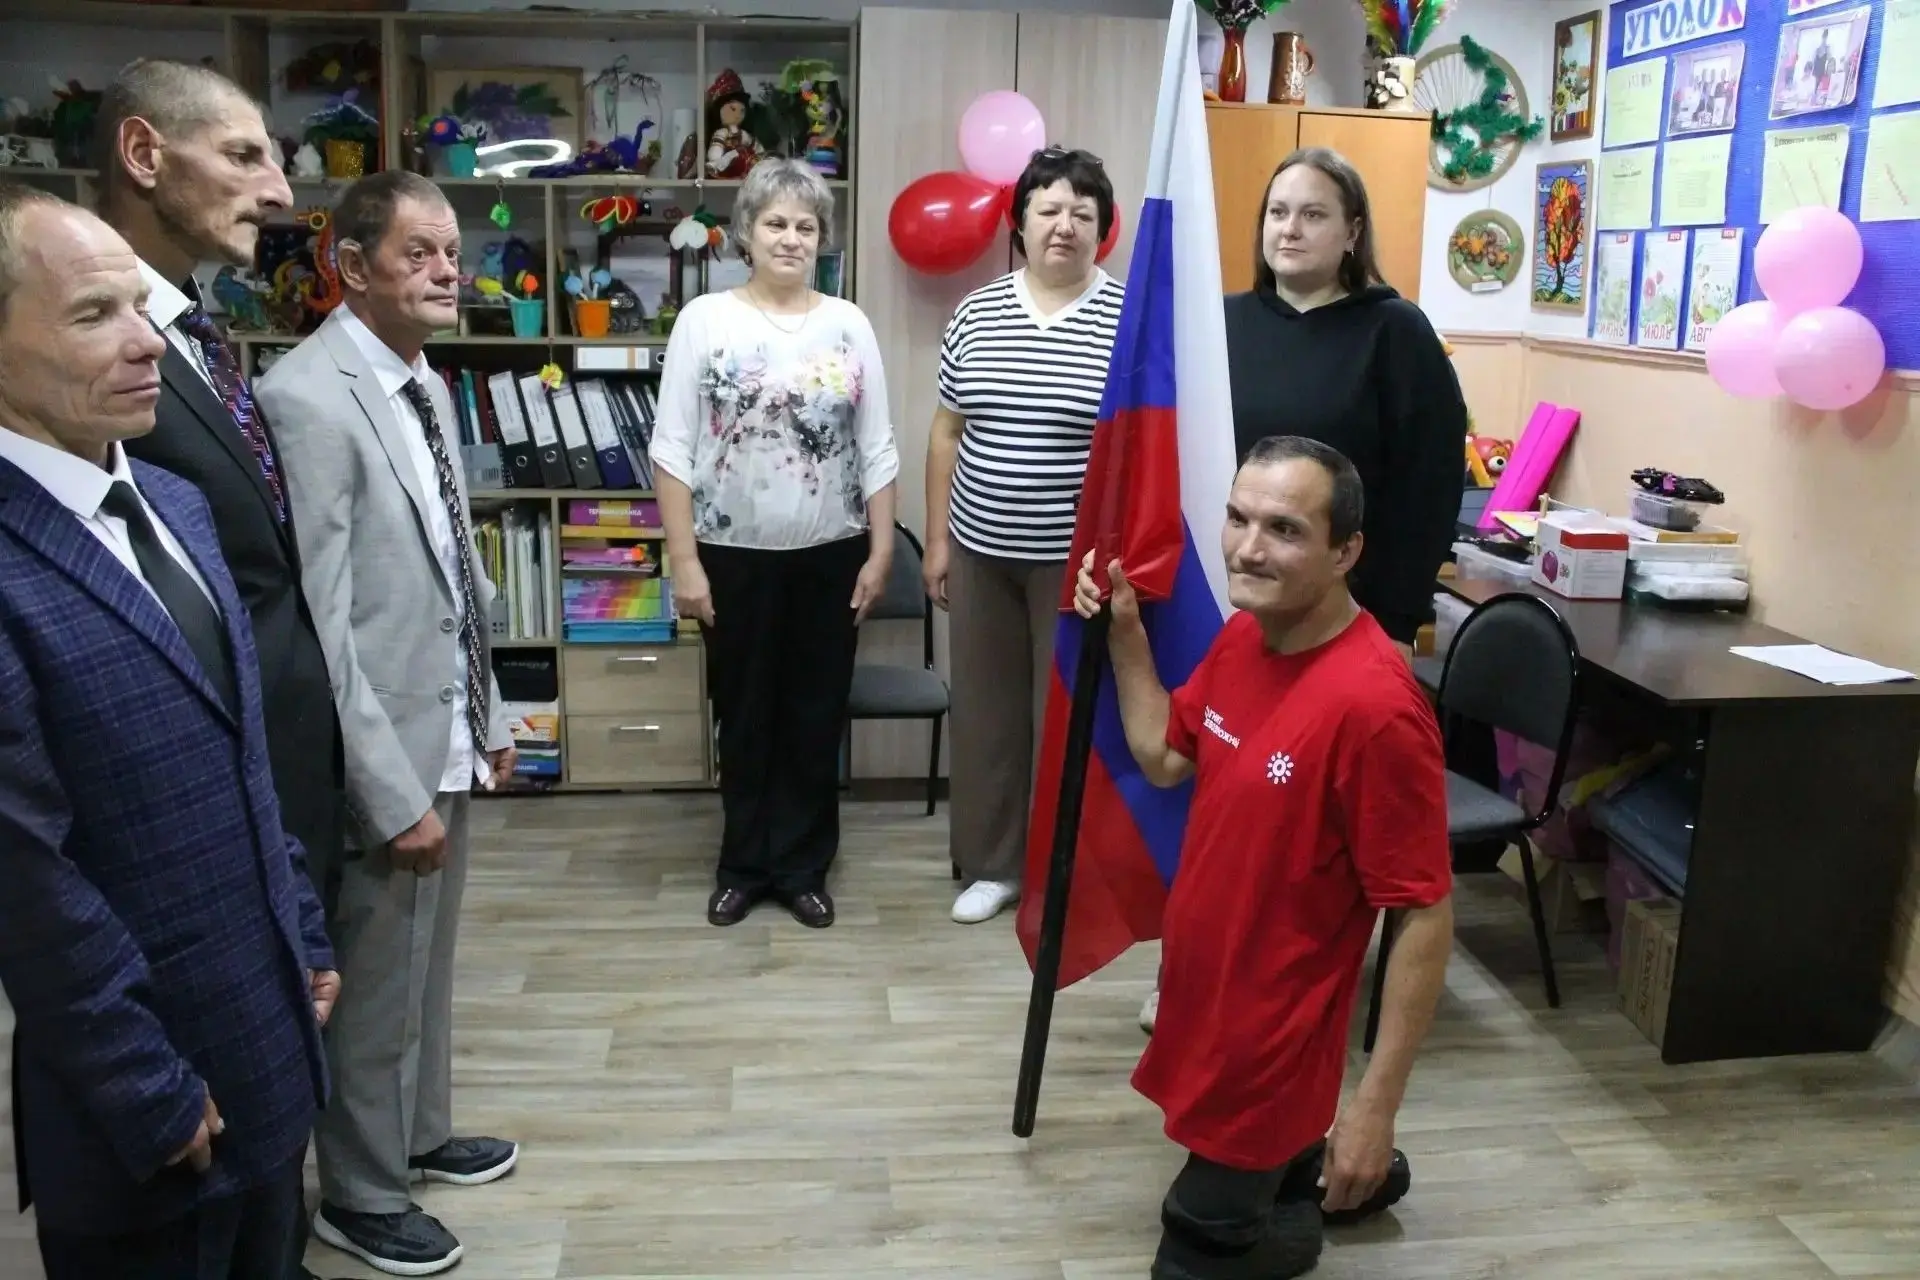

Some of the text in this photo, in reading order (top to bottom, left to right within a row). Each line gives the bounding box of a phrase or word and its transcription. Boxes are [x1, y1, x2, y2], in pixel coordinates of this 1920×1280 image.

[1627, 0, 1745, 51] УГОЛОК
[1643, 324, 1672, 341] ИЮЛЬ
[1689, 326, 1713, 343] АВГ
